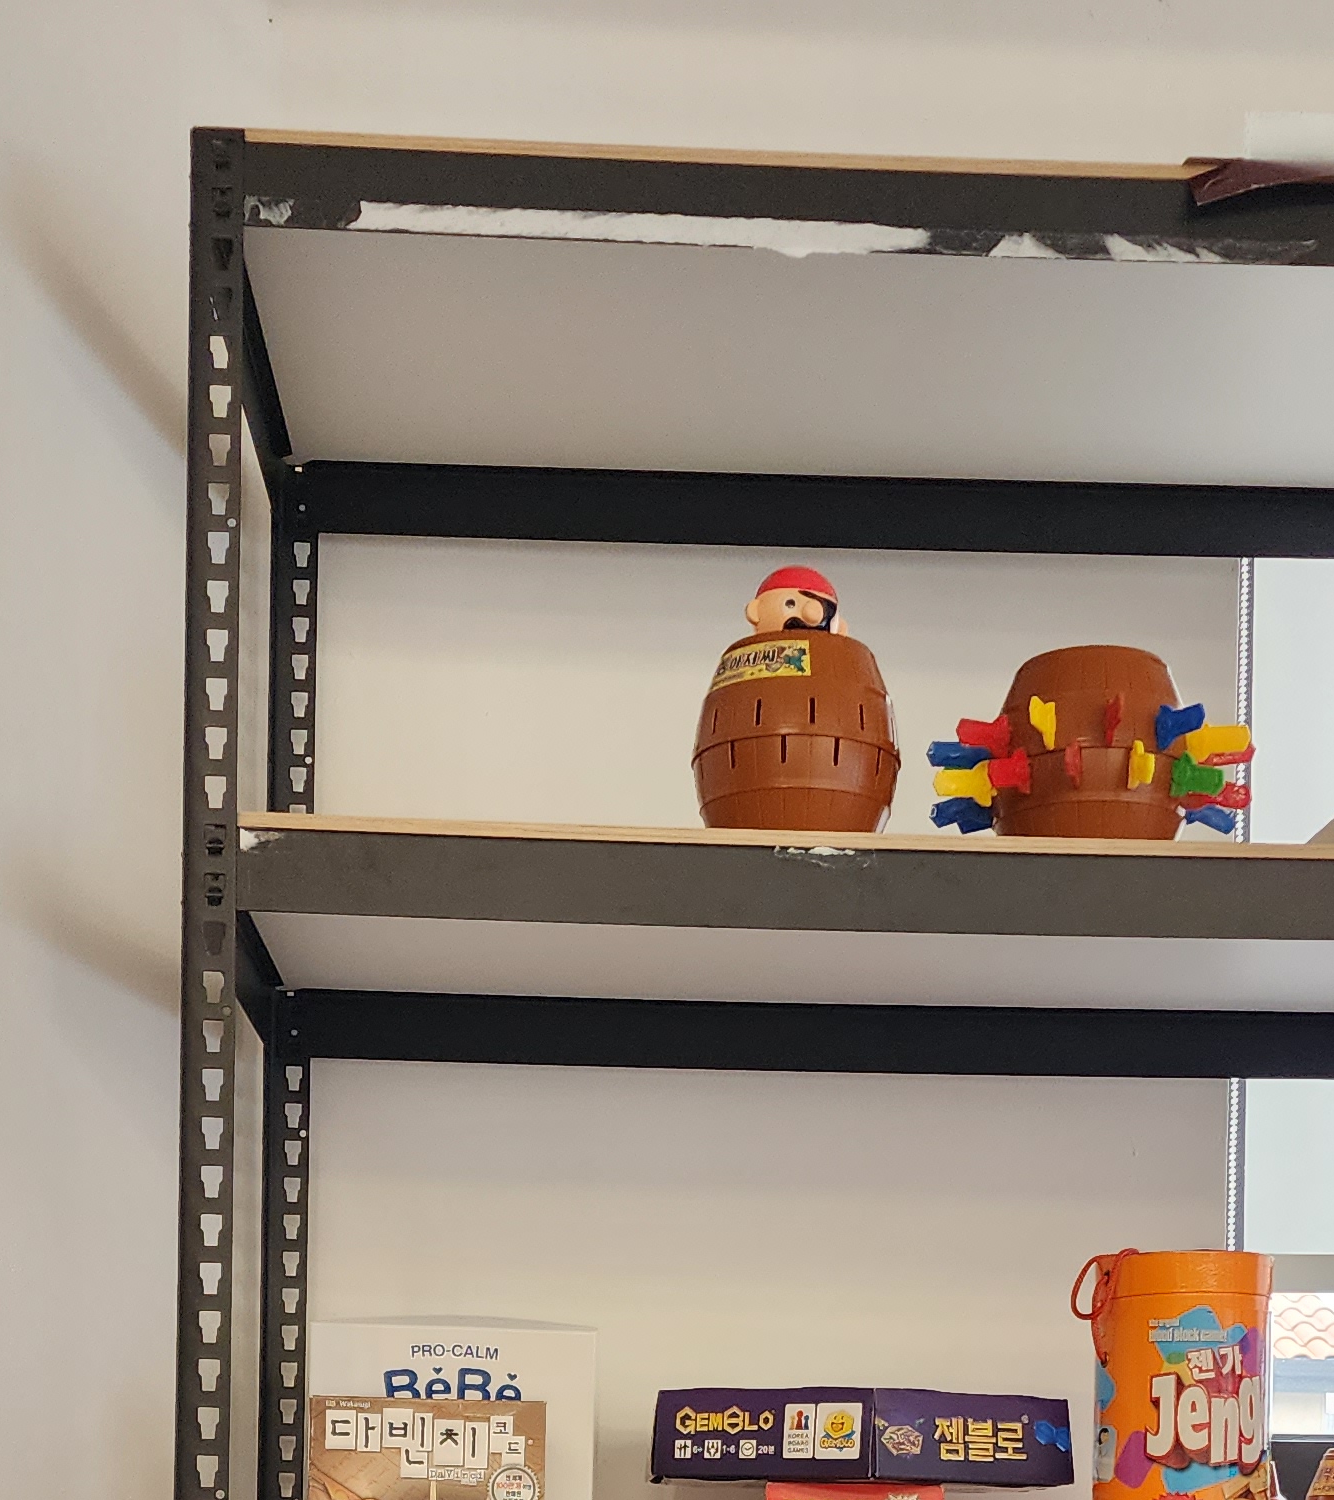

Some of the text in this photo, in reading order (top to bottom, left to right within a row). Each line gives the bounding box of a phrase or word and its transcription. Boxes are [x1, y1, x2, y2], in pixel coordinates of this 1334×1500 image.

[410, 1344, 500, 1361] PRO-CALM
[1187, 1345, 1243, 1381] 젠가
[675, 1405, 775, 1435] GEMBLO
[330, 1415, 523, 1466] 다빈치 코드
[933, 1415, 1028, 1463] 젬블로
